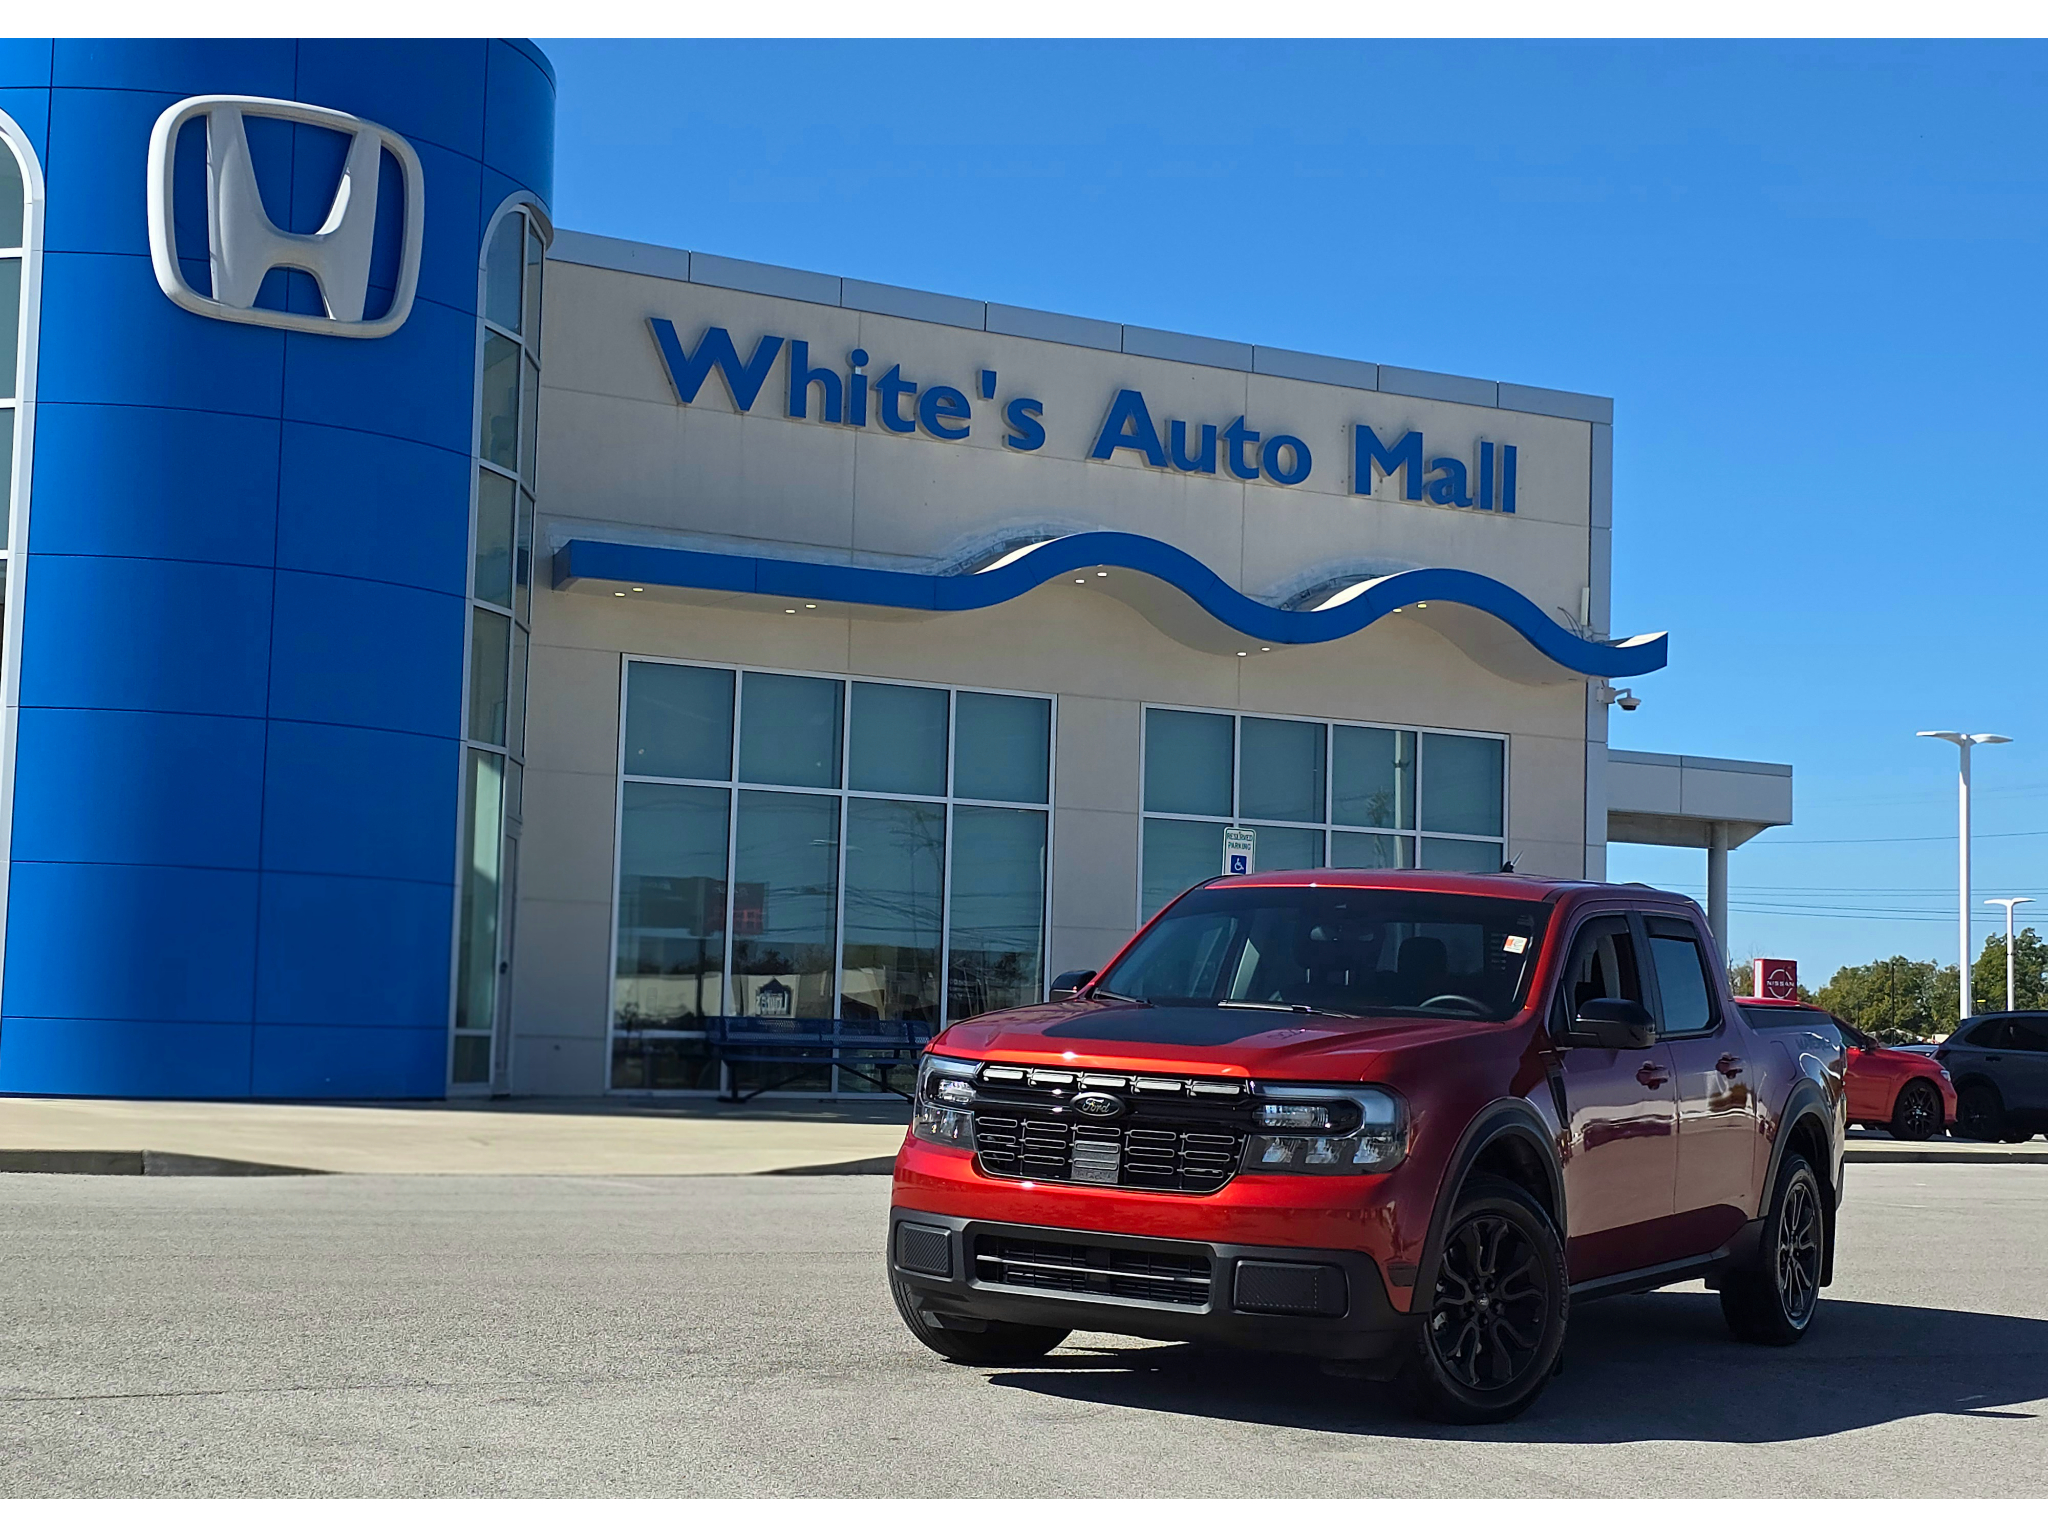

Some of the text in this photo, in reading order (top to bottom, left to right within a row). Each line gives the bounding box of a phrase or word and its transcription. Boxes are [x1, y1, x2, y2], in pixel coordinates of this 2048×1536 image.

[646, 317, 1517, 514] White's Auto Mall
[1227, 833, 1253, 841] RESERVED
[1228, 842, 1251, 850] PARKING
[1082, 1098, 1111, 1112] Ford
